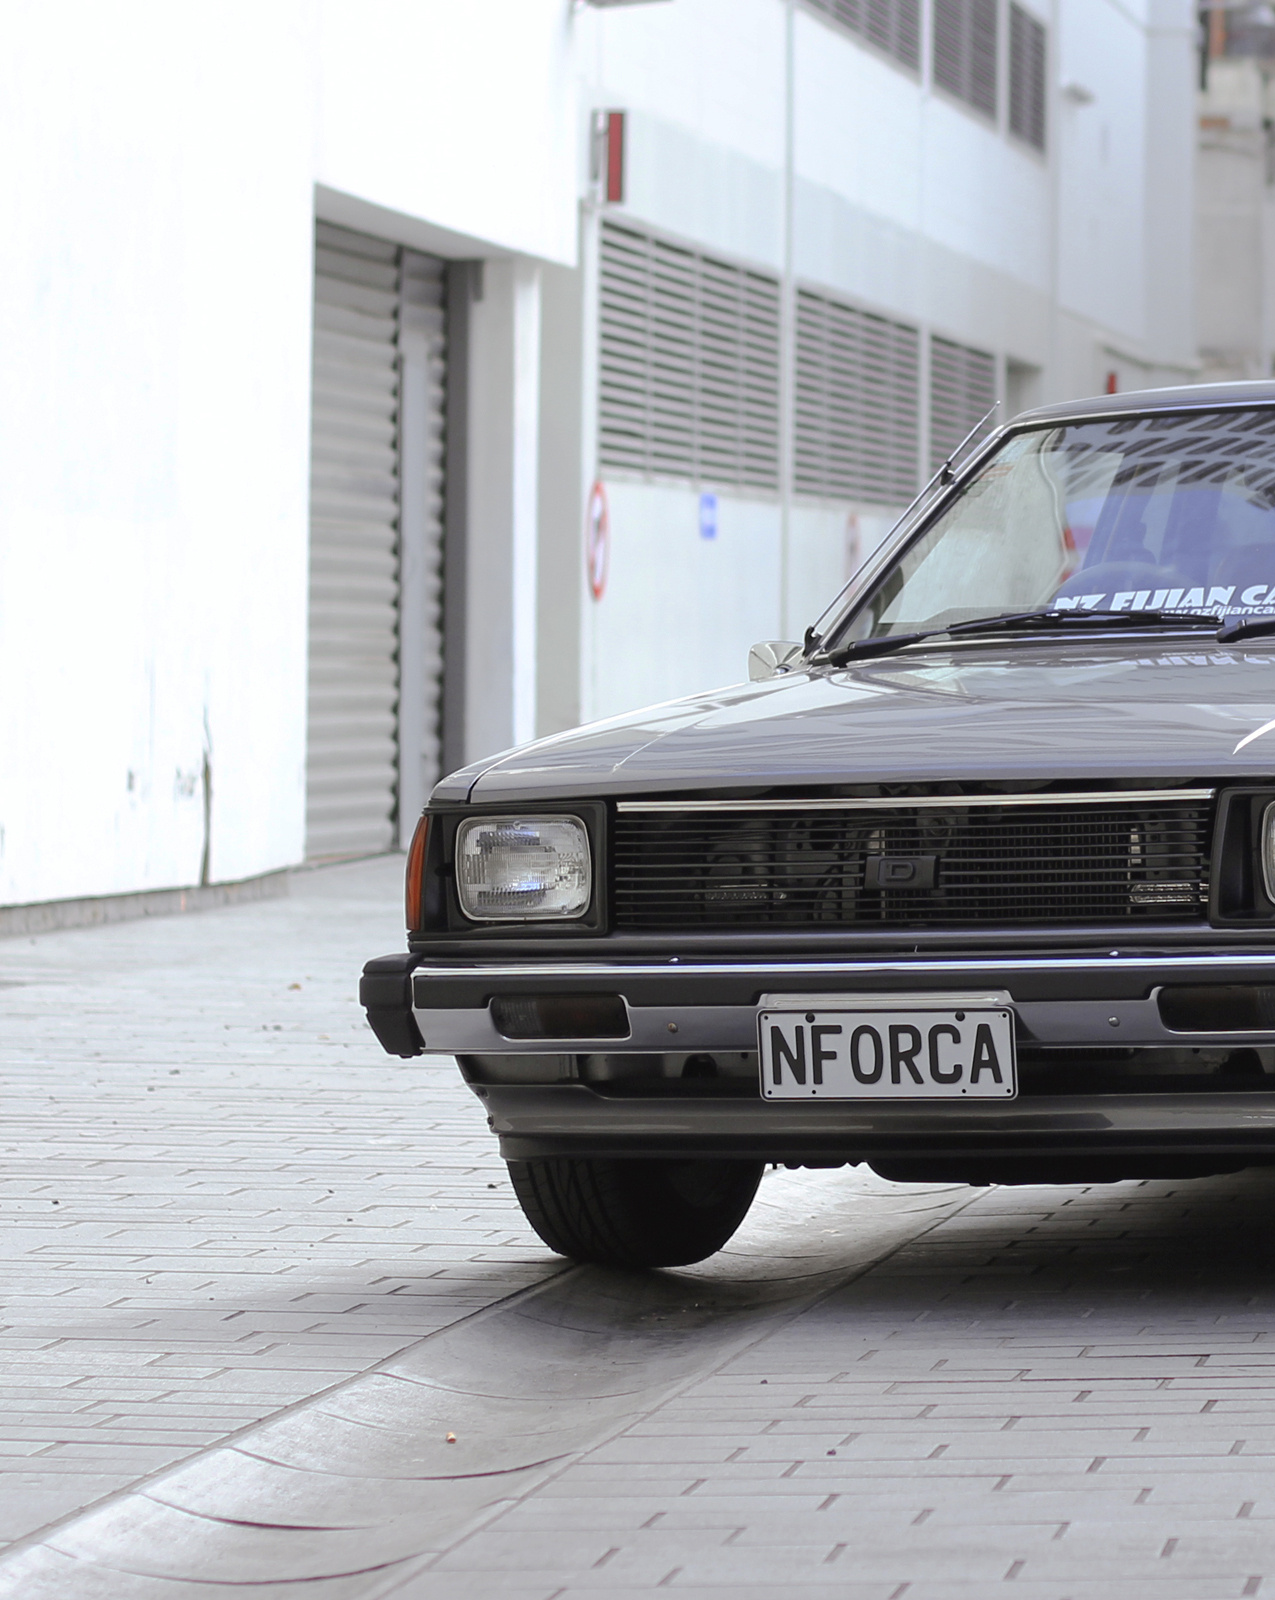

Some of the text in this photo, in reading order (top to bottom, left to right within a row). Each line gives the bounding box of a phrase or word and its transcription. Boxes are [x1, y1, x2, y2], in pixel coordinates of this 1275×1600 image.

[1053, 593, 1107, 611] NZ
[1109, 586, 1236, 611] FIJIAN
[770, 1023, 1003, 1085] NFORCA
